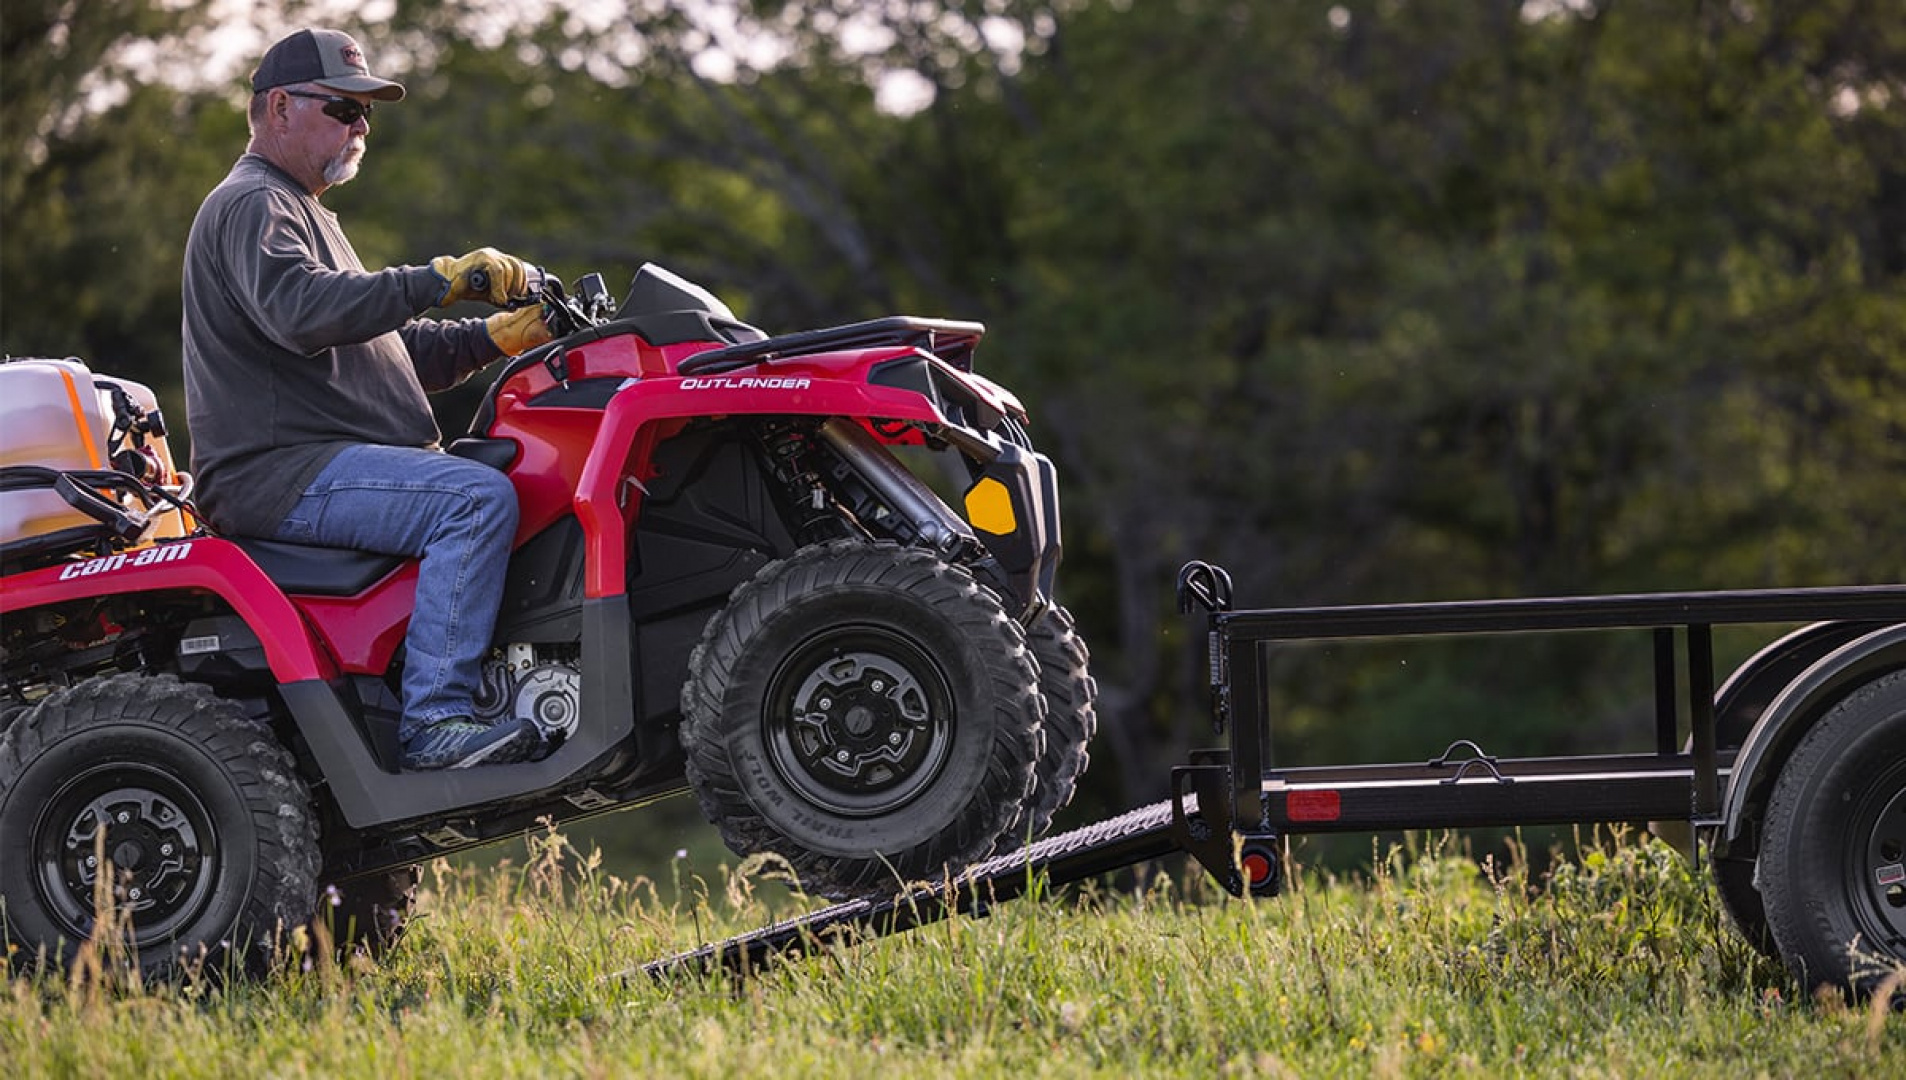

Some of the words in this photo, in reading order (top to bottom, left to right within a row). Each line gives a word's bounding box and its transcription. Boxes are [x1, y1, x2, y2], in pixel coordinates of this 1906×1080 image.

[680, 377, 811, 390] OUTLANDER
[58, 542, 193, 581] can-am
[738, 749, 784, 806] WOLF
[790, 809, 854, 839] TRAIL
